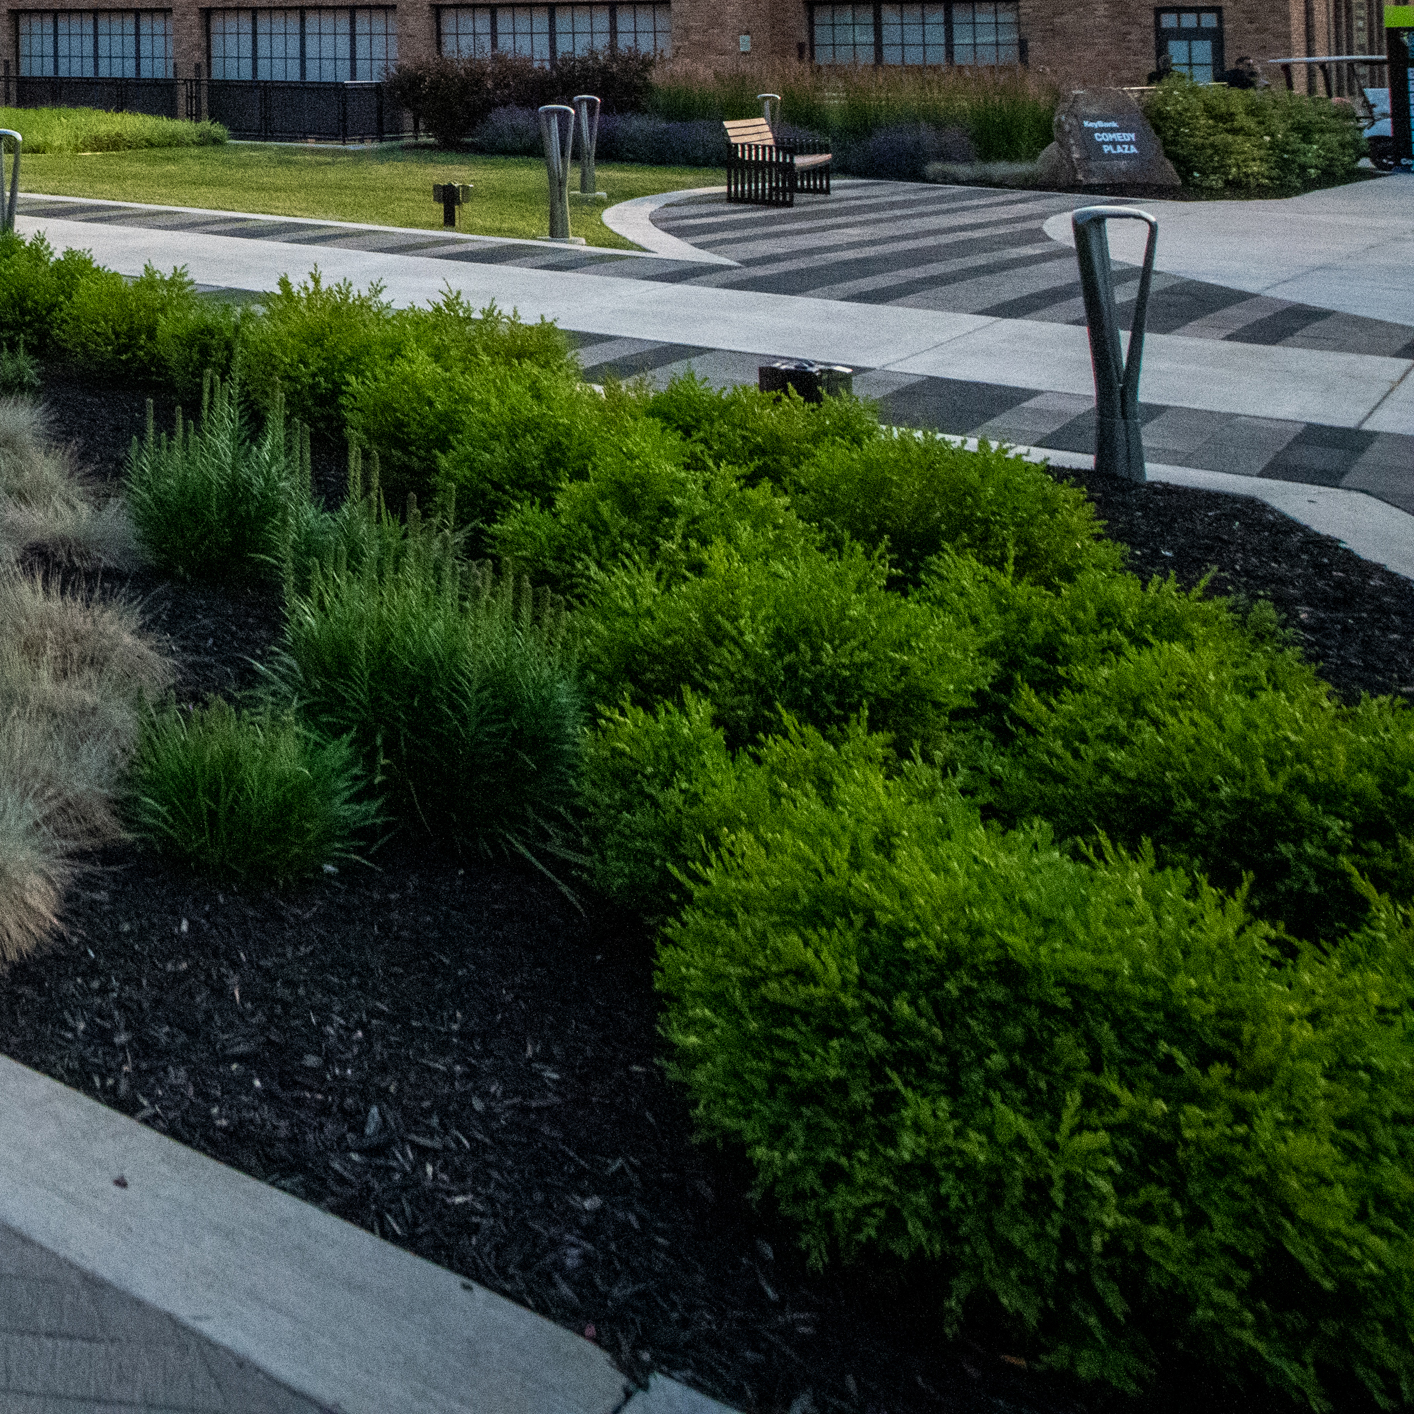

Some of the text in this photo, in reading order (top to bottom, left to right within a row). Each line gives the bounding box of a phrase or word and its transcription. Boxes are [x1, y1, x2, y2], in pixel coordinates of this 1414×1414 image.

[1083, 120, 1119, 128] KeyBank
[1094, 132, 1136, 142] COMEDY
[1102, 144, 1139, 154] PLAZA
